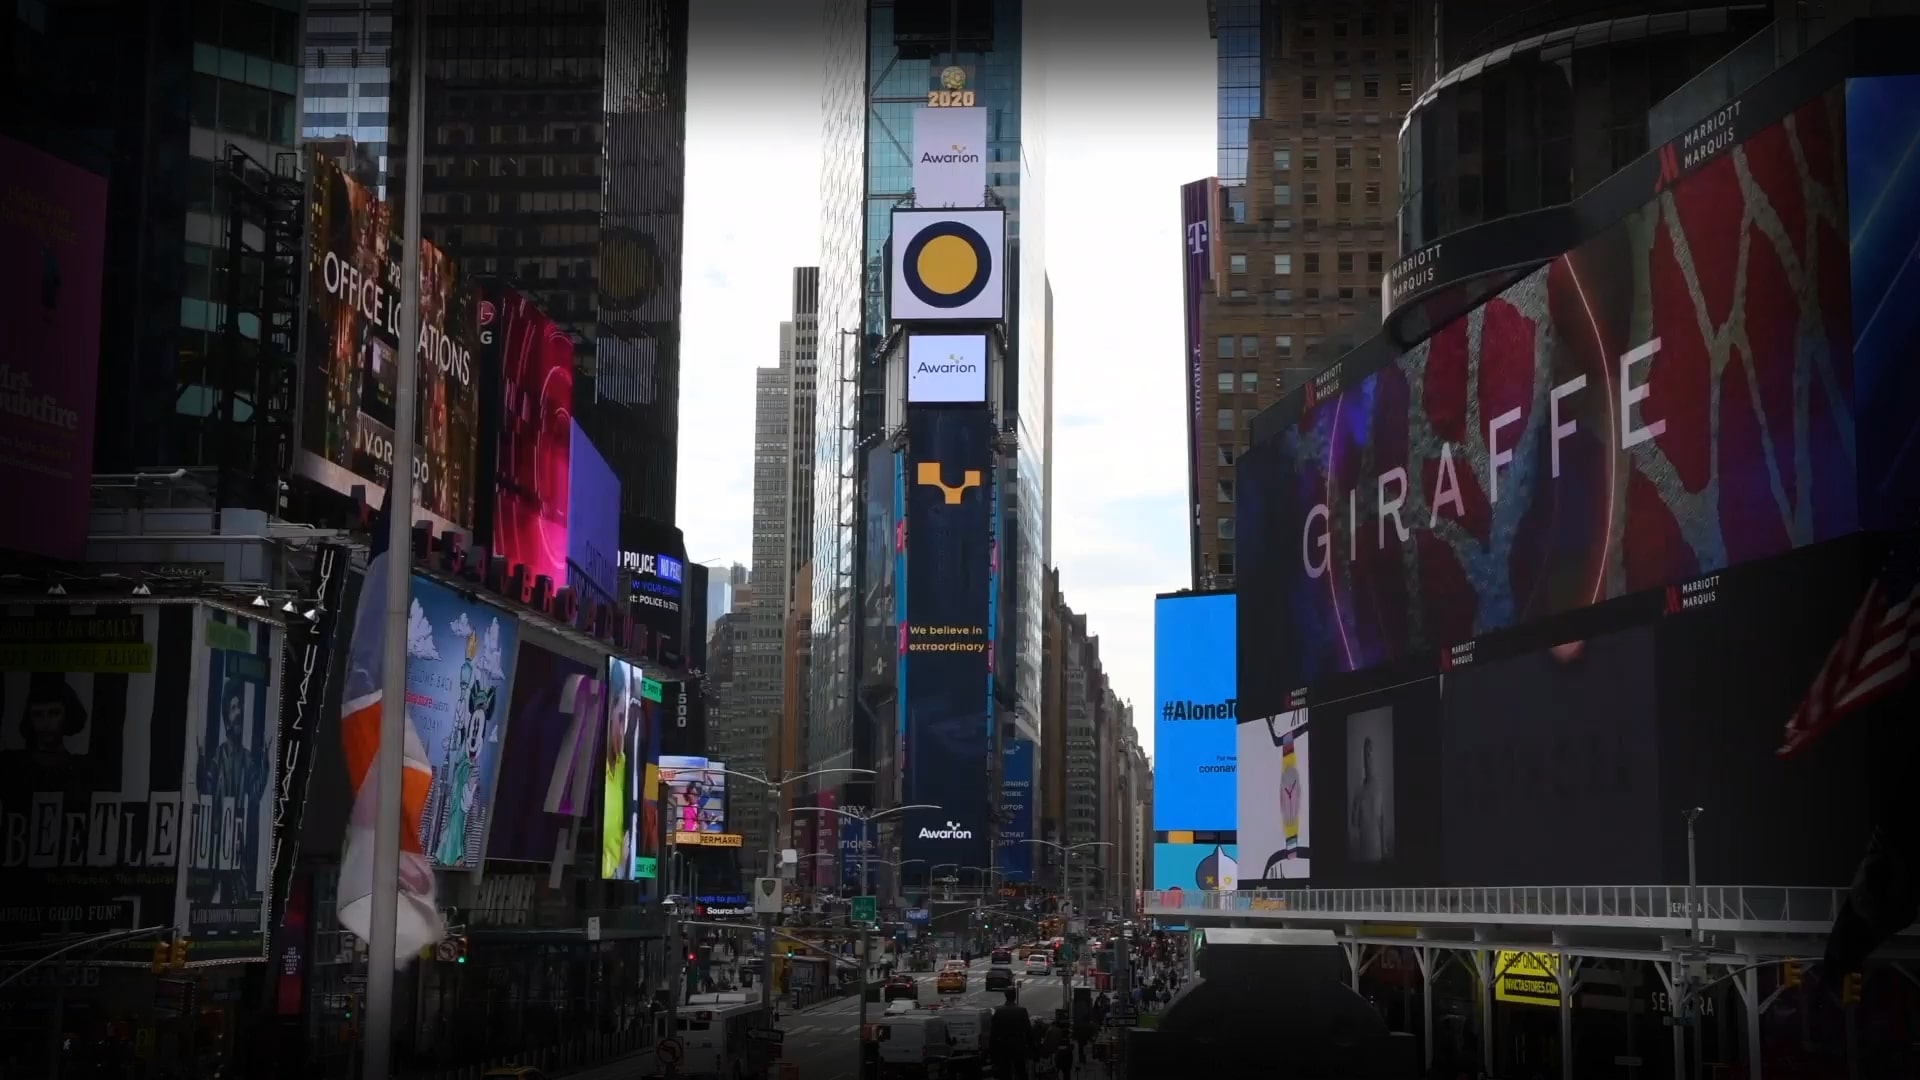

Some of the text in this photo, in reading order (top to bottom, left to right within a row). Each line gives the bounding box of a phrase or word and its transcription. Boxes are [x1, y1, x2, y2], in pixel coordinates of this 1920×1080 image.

[928, 90, 976, 107] 2020
[1683, 100, 1742, 147] MARRIOTT
[920, 148, 980, 164] Awarion
[1683, 126, 1735, 168] MARQUIS
[1391, 243, 1443, 283] MARRIOTT
[1391, 267, 1435, 305] MARQUIS
[323, 250, 471, 387] OFFICE LATIONS
[916, 359, 977, 374] Awarion
[1315, 362, 1344, 388] MARRIOTT
[1315, 379, 1341, 401] MARQUIS
[364, 427, 430, 484] VORDO
[1302, 337, 1667, 579] GIRAFFE
[1682, 575, 1720, 594] MARRIOTT
[639, 595, 663, 607] POLICE
[1682, 591, 1716, 608] MARQUIS
[909, 625, 983, 635] We believe in
[909, 642, 985, 653] extraordinary
[677, 681, 687, 728] 1500
[1199, 765, 1236, 773] coronav
[918, 822, 972, 840] Awarion
[47, 904, 83, 921] GOOD
[1650, 991, 1715, 1017] SERA
